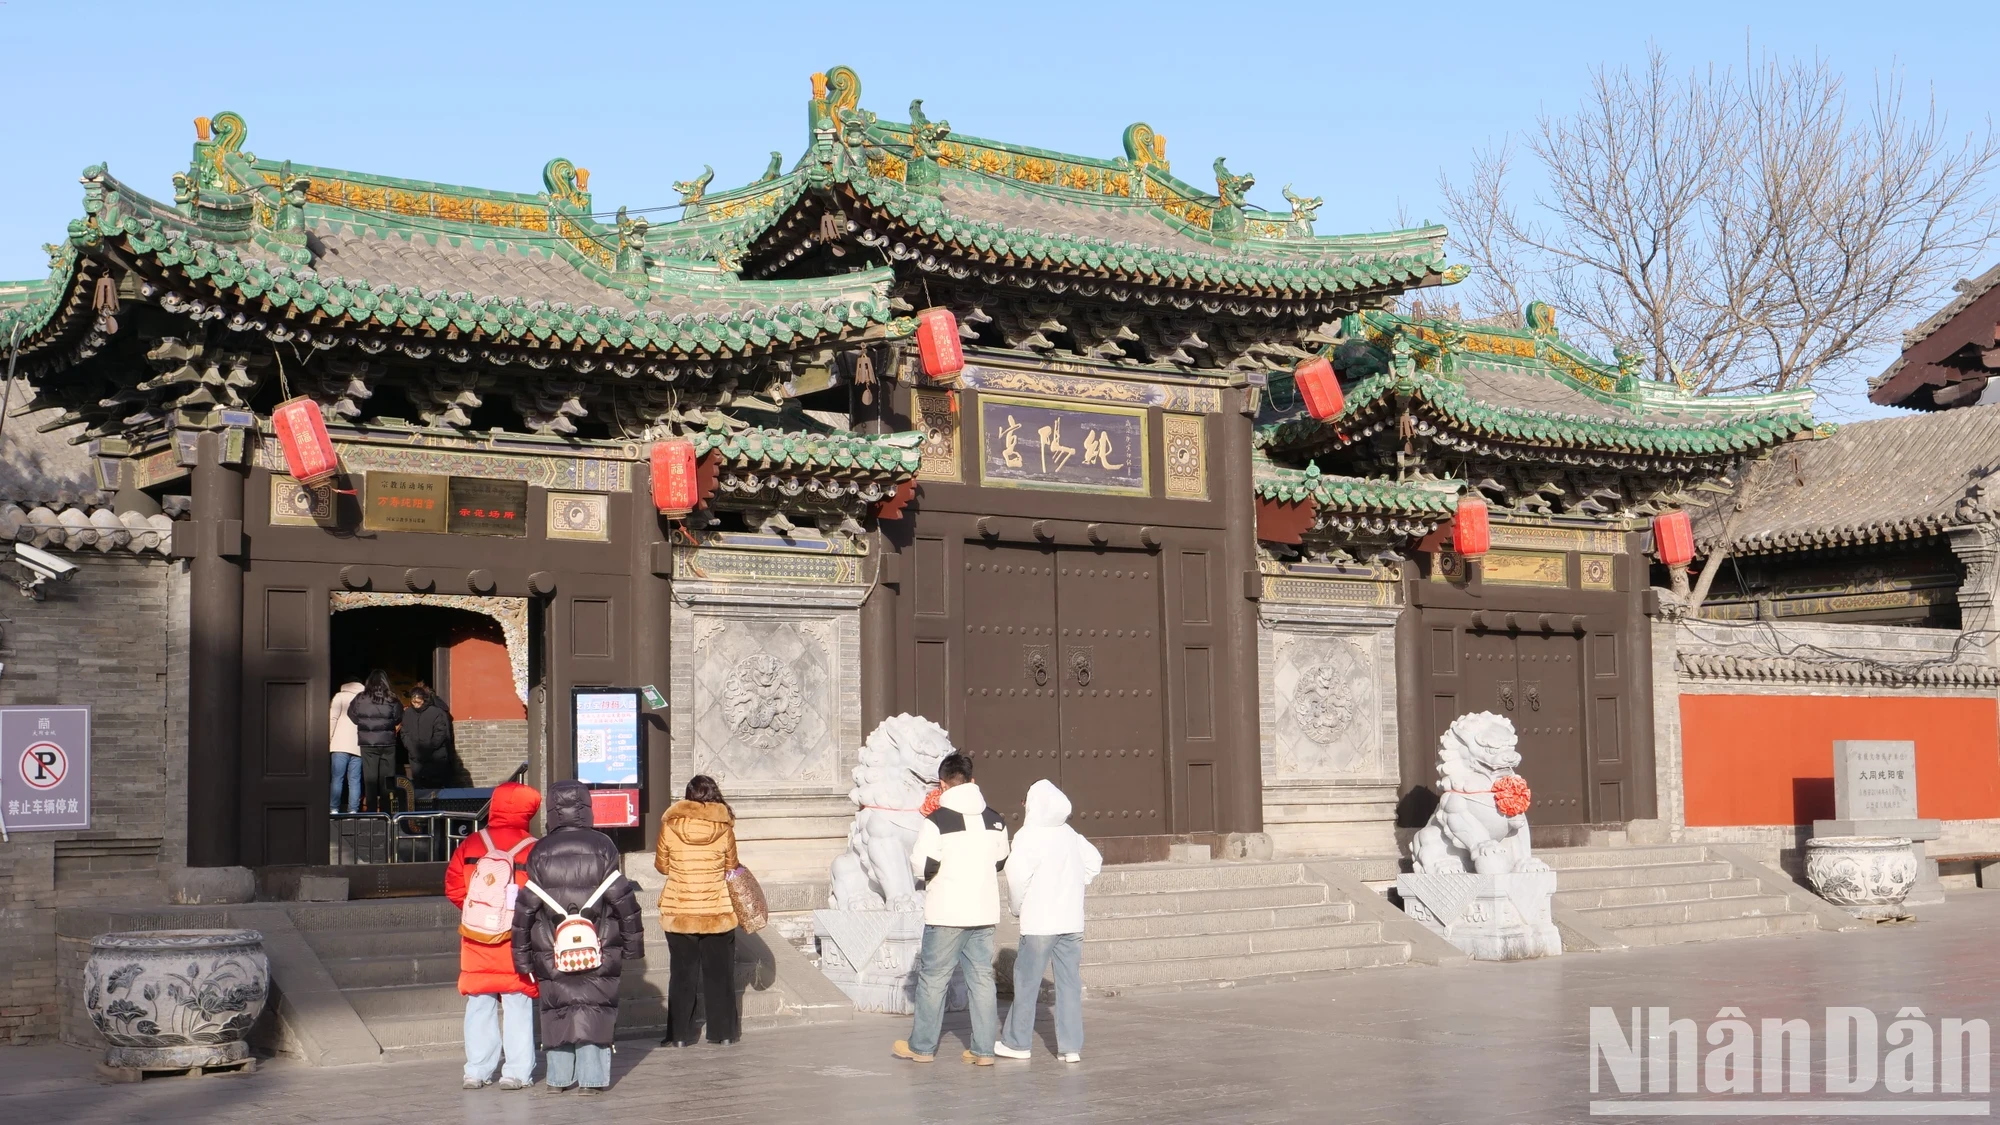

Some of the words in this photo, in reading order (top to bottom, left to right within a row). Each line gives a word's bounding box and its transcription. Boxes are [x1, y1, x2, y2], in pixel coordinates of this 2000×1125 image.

[381, 480, 434, 491] 宗教活动场所
[378, 496, 436, 510] 万寿纯阳宫
[459, 508, 515, 520] 示范场所
[35, 752, 56, 779] P
[1859, 770, 1904, 780] 大同纯阳宫
[8, 798, 78, 815] 禁止车辆停放
